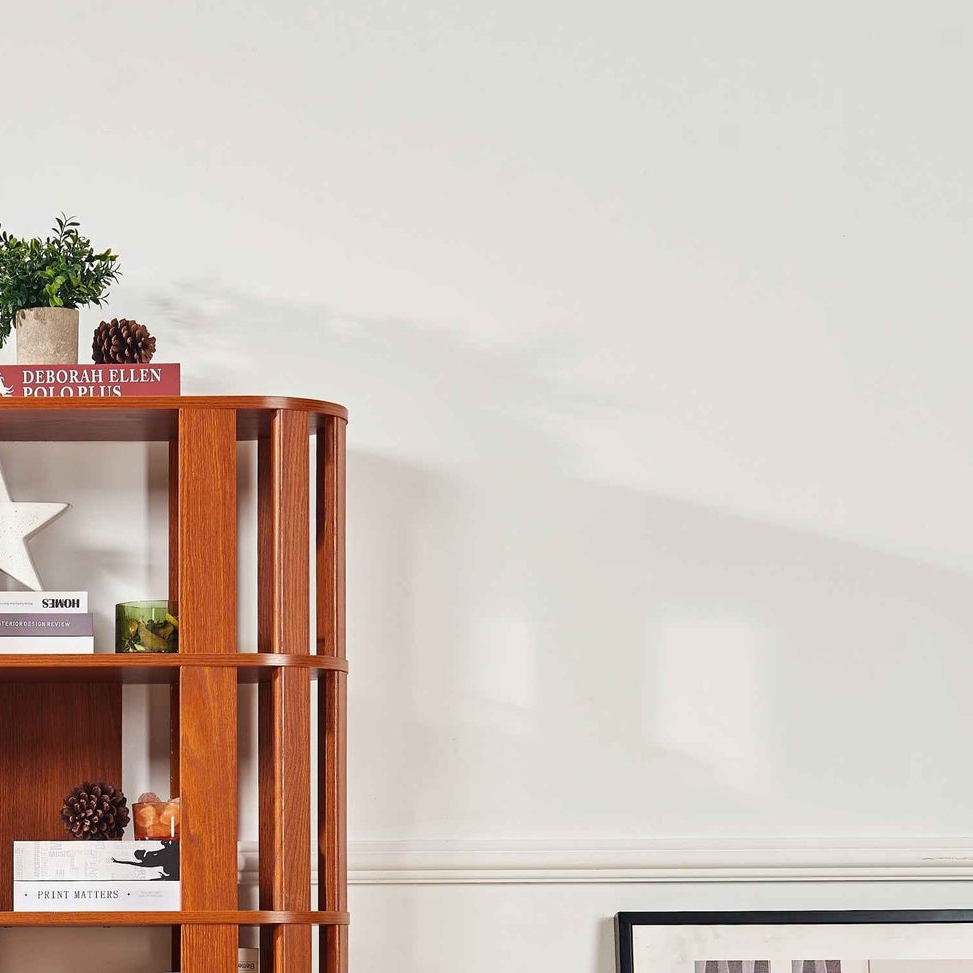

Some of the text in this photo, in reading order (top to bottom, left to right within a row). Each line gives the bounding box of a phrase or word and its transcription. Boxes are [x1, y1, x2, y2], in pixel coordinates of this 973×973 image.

[22, 368, 162, 384] DEBORAH ELLEN
[42, 598, 80, 608] HOMES
[37, 890, 119, 899] PRINT MATTERS
